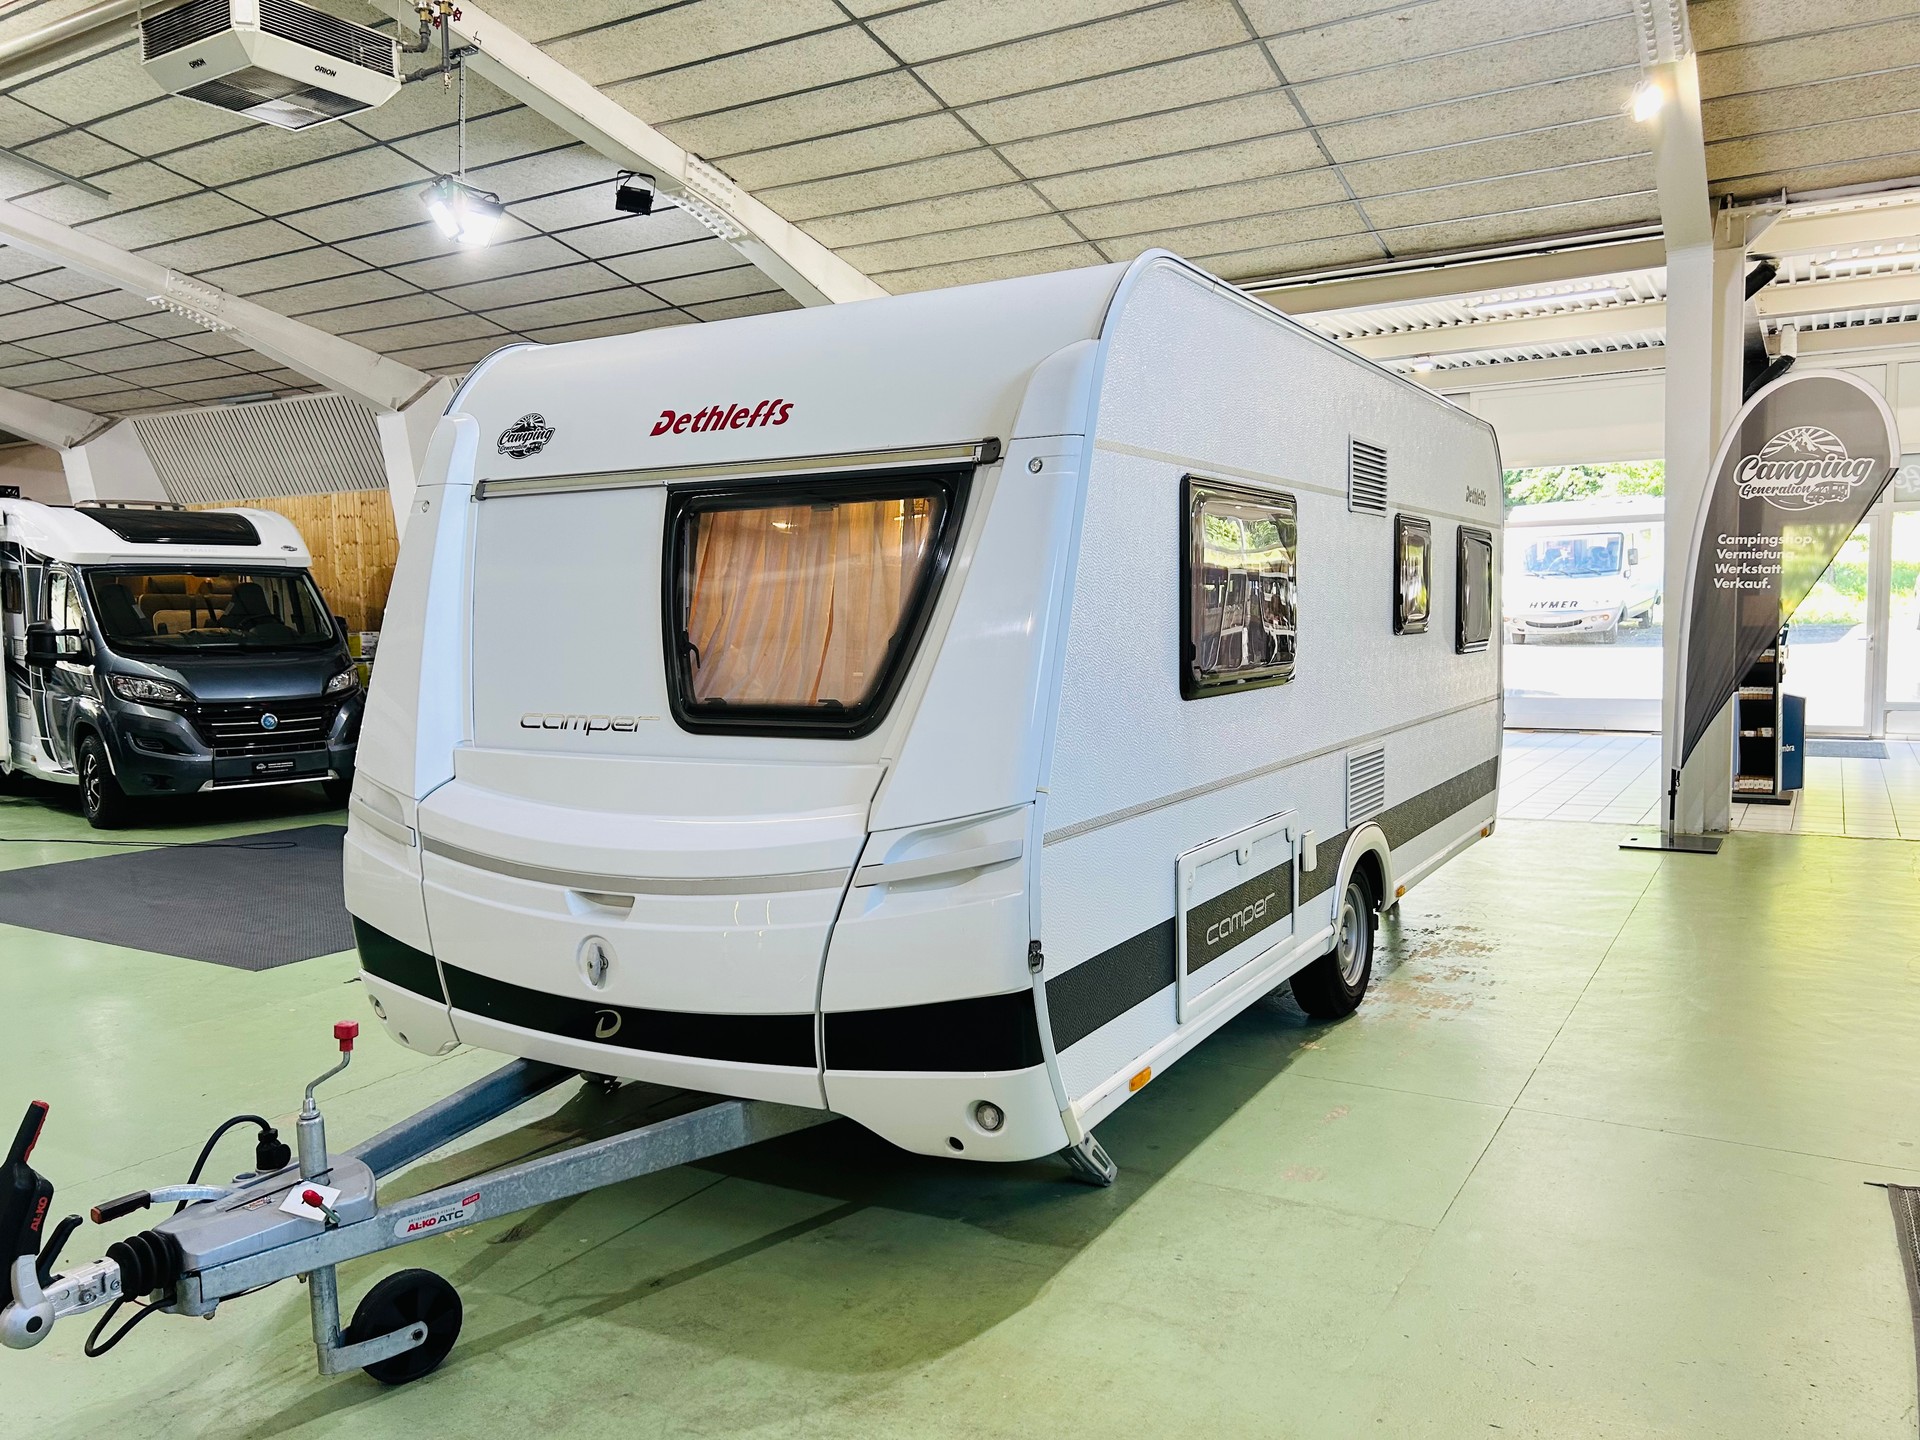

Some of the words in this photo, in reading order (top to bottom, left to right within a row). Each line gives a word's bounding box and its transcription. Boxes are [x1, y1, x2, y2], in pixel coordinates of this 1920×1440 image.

[314, 64, 337, 77] ORION
[649, 398, 795, 437] Dethleffs
[499, 429, 554, 445] Camping
[1735, 455, 1872, 486] Camping
[1741, 483, 1812, 498] Generation
[1717, 533, 1817, 548] Campingshop.
[1716, 548, 1798, 562] Vermietung.
[1714, 563, 1785, 574] Werkstatt.
[1713, 577, 1771, 589] Verkauf.
[1529, 600, 1579, 609] HYMER
[520, 712, 660, 736] camper
[1206, 892, 1276, 946] camper
[437, 1209, 464, 1224] ATC
